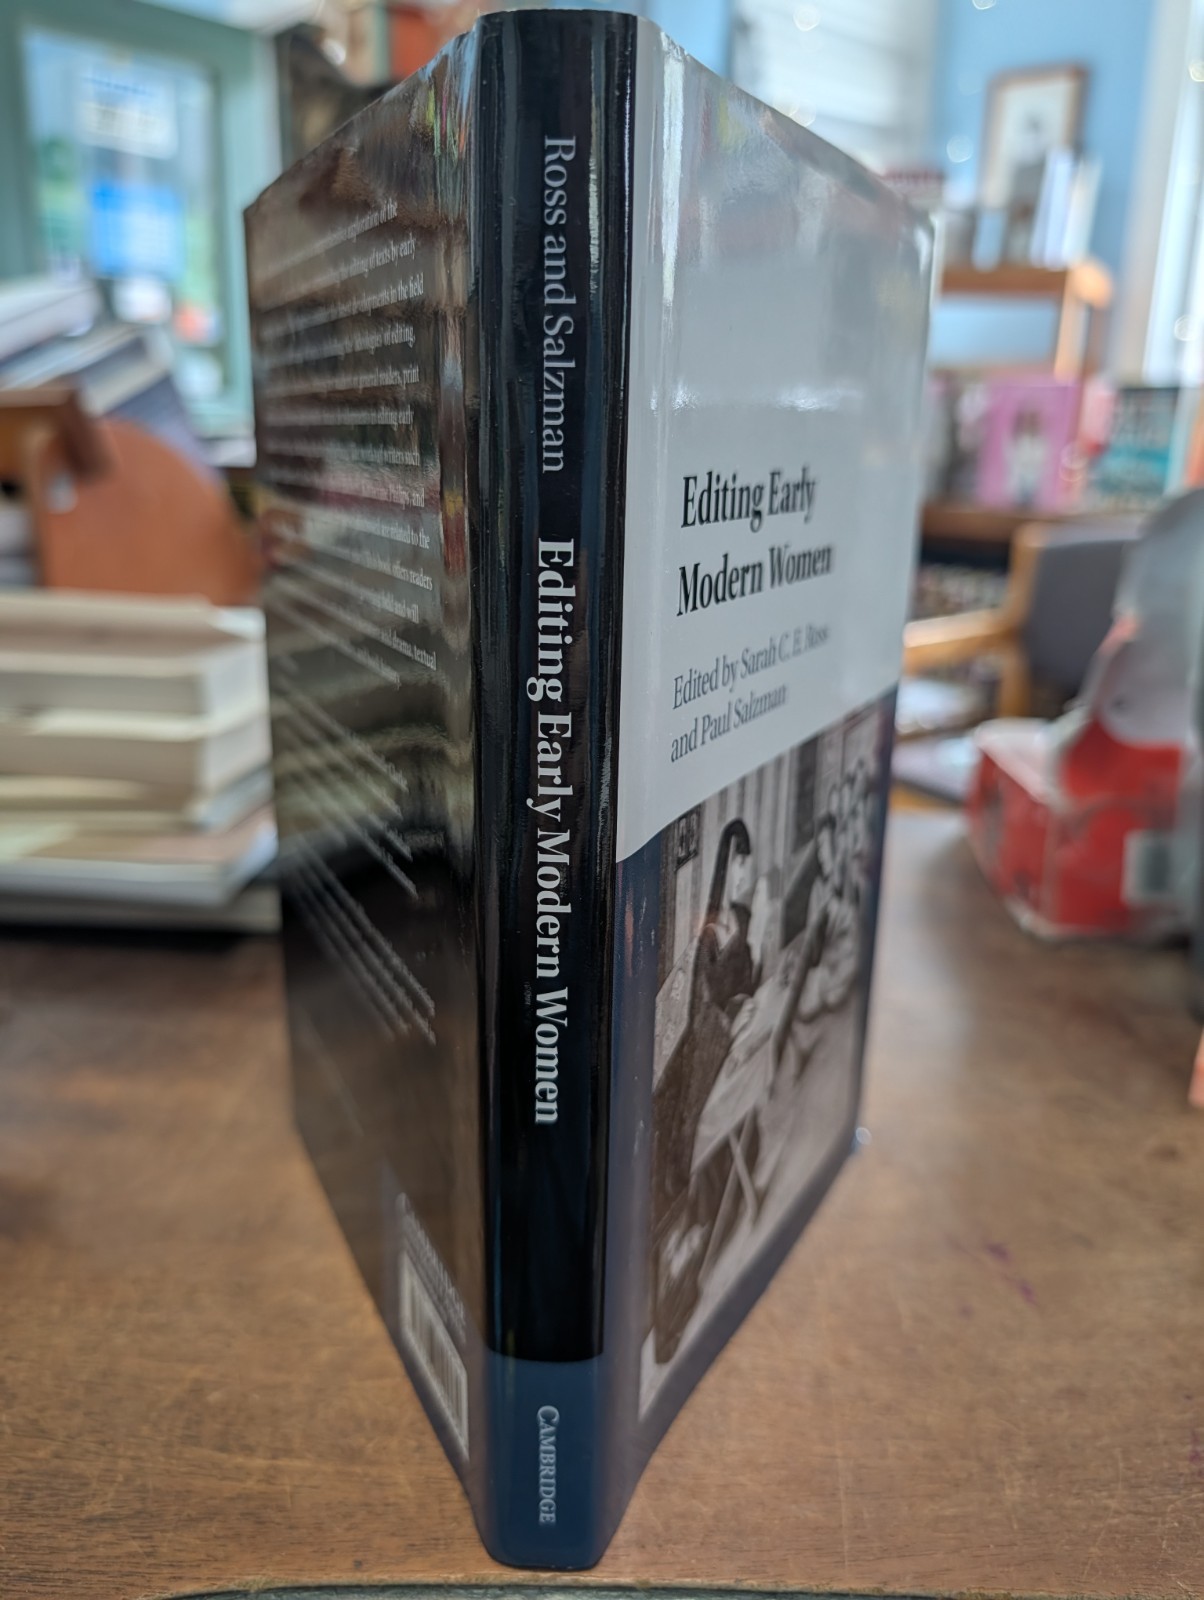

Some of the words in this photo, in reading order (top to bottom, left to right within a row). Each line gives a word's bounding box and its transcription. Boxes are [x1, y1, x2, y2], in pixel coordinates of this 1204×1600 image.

[387, 197, 398, 219] the
[544, 136, 576, 226] Ross
[391, 239, 399, 266] by
[399, 231, 417, 260] early
[543, 235, 577, 306] and
[390, 284, 398, 303] in
[397, 279, 409, 301] the
[409, 272, 425, 298] field
[391, 323, 416, 349] editing,
[402, 363, 420, 391] print
[542, 315, 576, 474] Salzman
[398, 403, 415, 431] early
[405, 445, 420, 466] such
[412, 487, 425, 508] and
[680, 470, 765, 533] Editing
[767, 464, 817, 523] Early
[410, 528, 419, 547] to
[418, 527, 431, 550] the
[409, 567, 433, 592] readers
[676, 552, 764, 617] Modern
[768, 543, 834, 590] Women
[406, 602, 420, 625] will
[526, 536, 577, 703] Editing
[392, 630, 414, 661] drama,
[413, 646, 437, 671] textual
[672, 656, 720, 710] Edited
[720, 653, 739, 693] by
[739, 638, 777, 680] Sarah
[778, 634, 792, 662] C.
[670, 716, 699, 763] and
[699, 701, 733, 746] Paul
[733, 683, 788, 730] Salzman
[526, 710, 574, 823] Early
[535, 827, 572, 979] Modern
[534, 986, 569, 1125] Women
[537, 1405, 560, 1525] CAMBRIDGE
